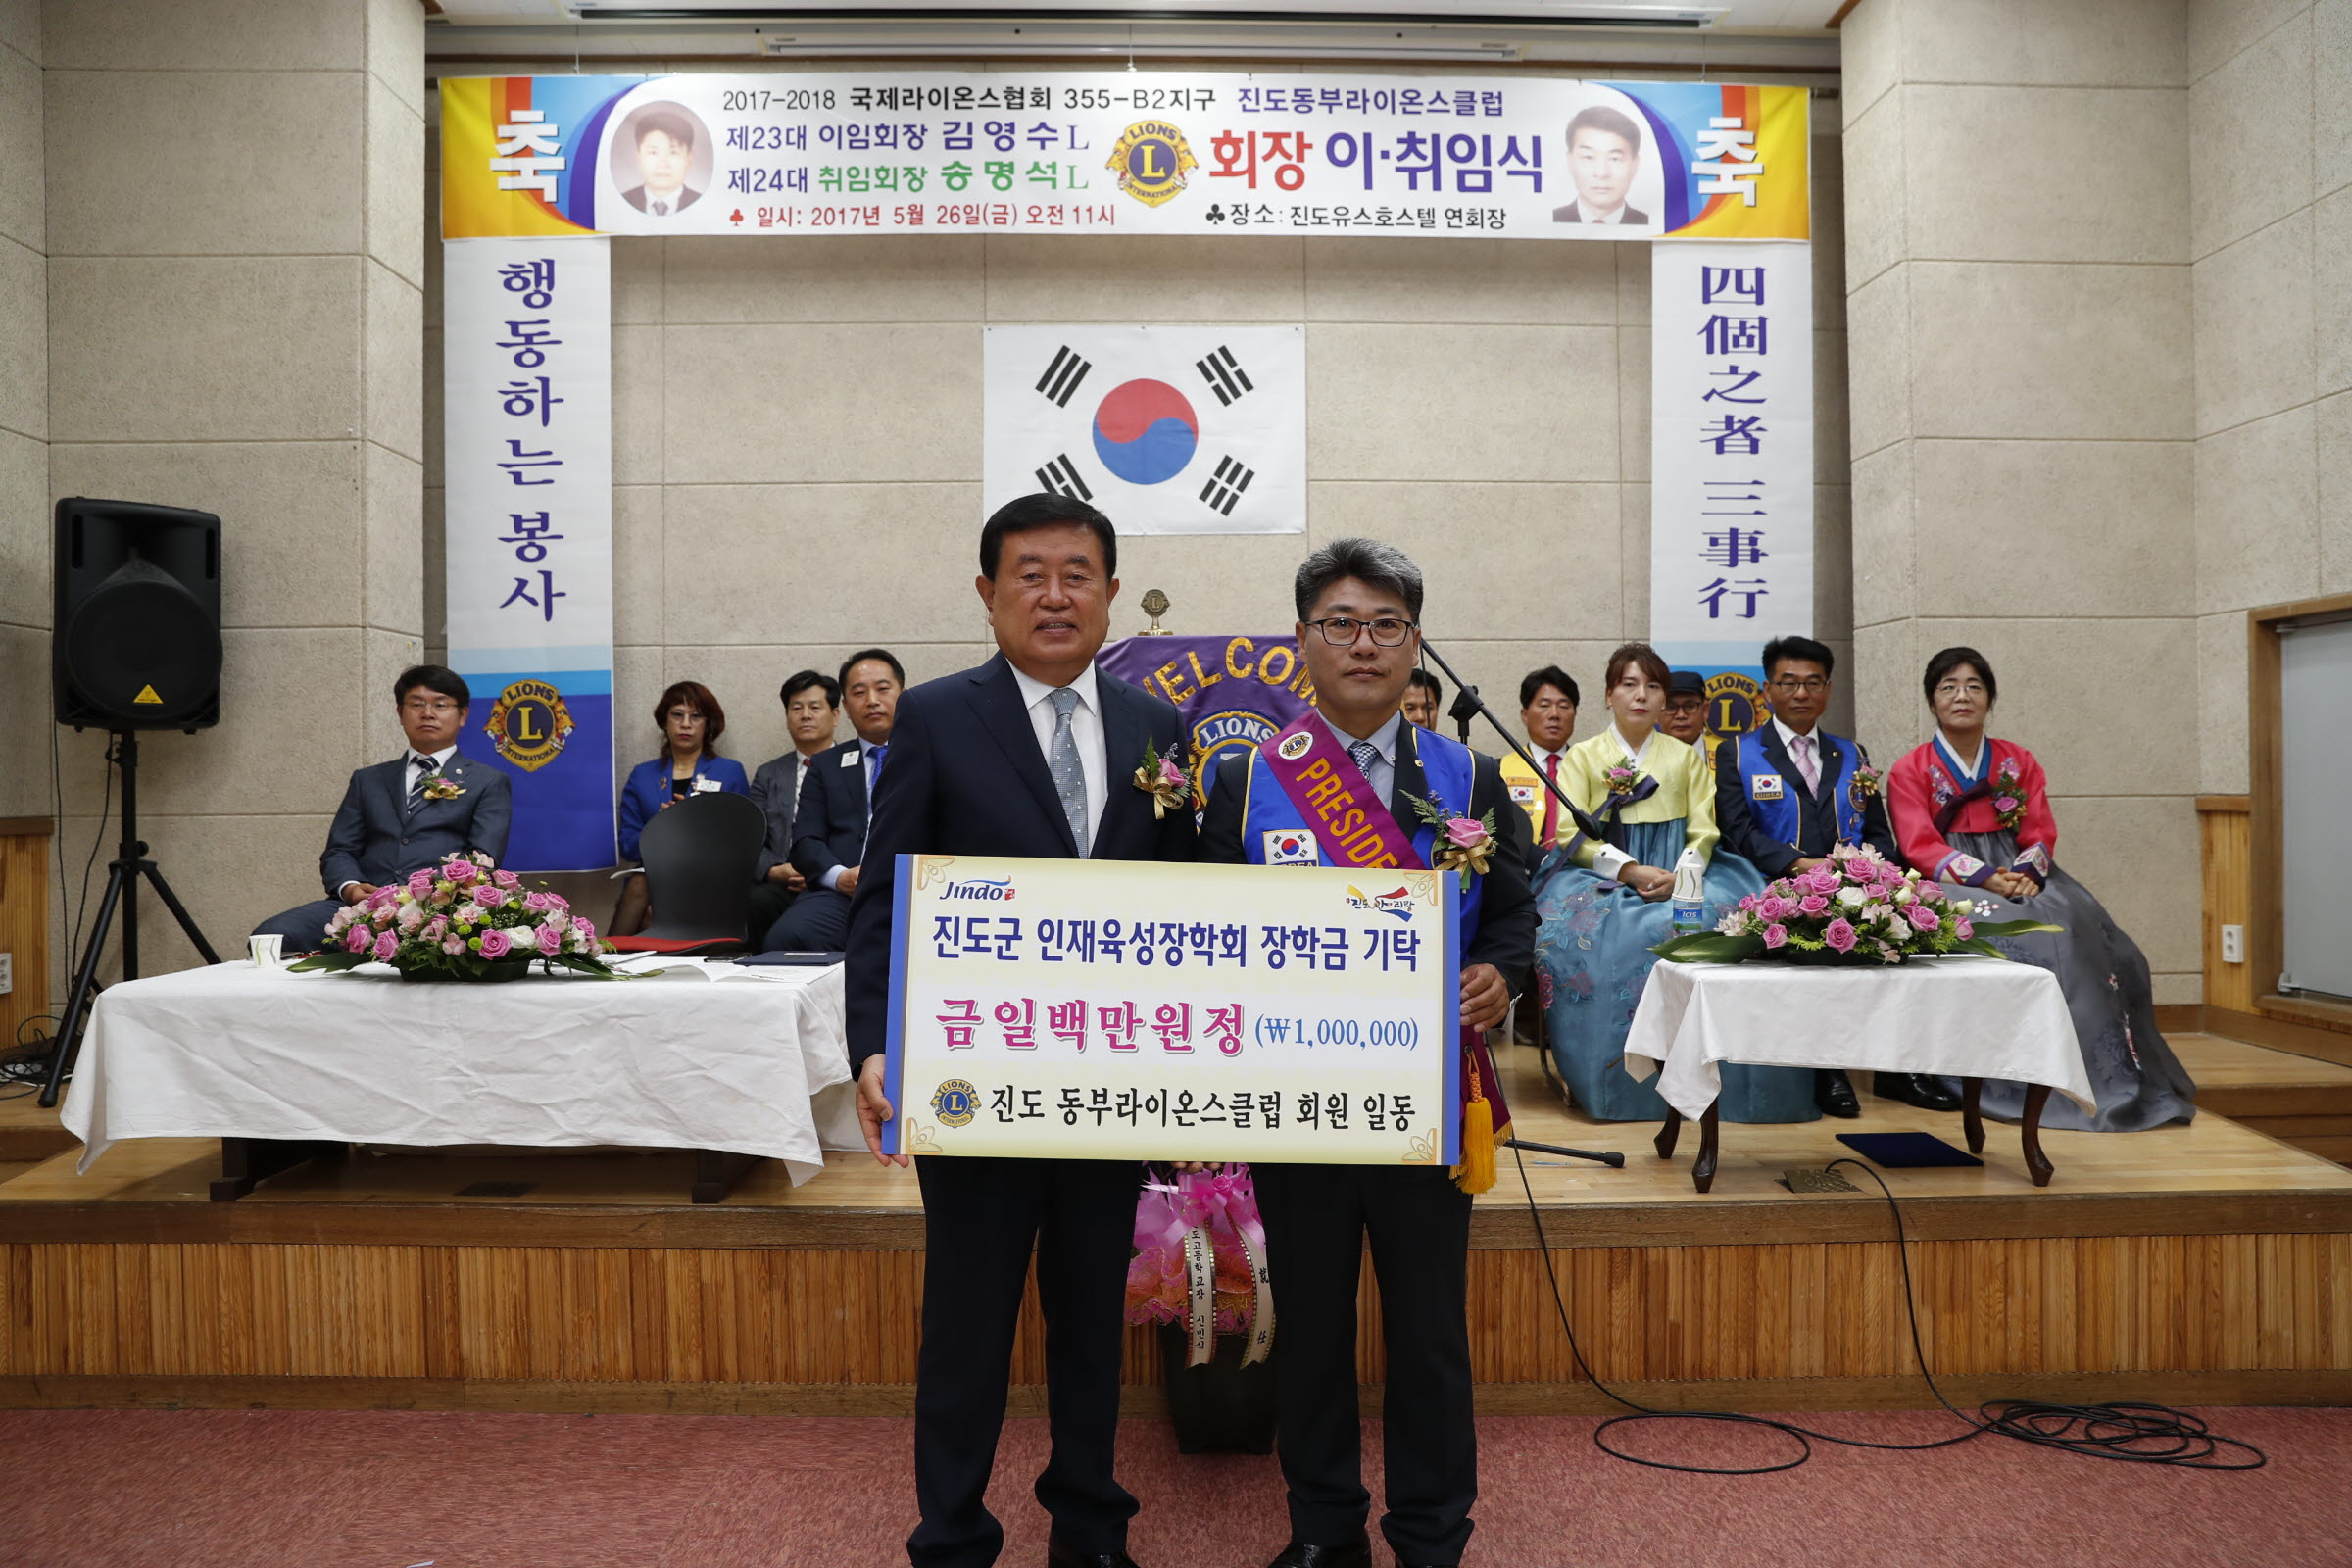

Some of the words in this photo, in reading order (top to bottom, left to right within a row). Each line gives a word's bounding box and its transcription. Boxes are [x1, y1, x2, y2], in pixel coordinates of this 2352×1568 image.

[725, 87, 836, 110] 2017-2018
[850, 86, 1050, 111] 국제라이온스협회
[1064, 88, 1216, 111] 355-B2지구
[1239, 88, 1502, 117] 진도동부라이온스클럽
[726, 124, 807, 151] 제23대
[819, 123, 928, 151] 이임회장
[1129, 123, 1177, 140] LIONS
[490, 110, 565, 202] 축
[1141, 145, 1166, 177] L
[1209, 129, 1313, 191] 회장
[1691, 117, 1764, 206] 축
[728, 167, 808, 194] 제24대
[818, 165, 928, 193] 취임회장
[758, 206, 801, 227] 일시:
[811, 205, 880, 226] 2017년
[894, 204, 923, 225] 5월
[937, 203, 1017, 226] 26일(금)
[1026, 204, 1063, 225] 오전
[1073, 205, 1114, 225] 11시
[1291, 206, 1436, 228] 진도유스호스텔
[1445, 208, 1506, 230] 연회장
[495, 259, 564, 486] 행동하는
[1697, 266, 1768, 455] 四個之者
[1698, 480, 1769, 619] 三事行
[498, 512, 566, 622] 봉사
[1143, 637, 1317, 707] ELCOM
[1708, 676, 1755, 694] LIONS
[507, 683, 555, 701] LIONS
[518, 707, 543, 740] L
[1718, 699, 1742, 731] L
[939, 881, 1003, 901] Jindo
[933, 916, 1023, 960] 진도군
[1038, 919, 1246, 967] 인재육성장학회
[1261, 925, 1349, 970] 장학금
[1363, 929, 1421, 972] 기탁
[1255, 1014, 1418, 1051] (₩1,000,000)
[942, 1081, 971, 1092] LIONS
[950, 1095, 963, 1110] L
[991, 1085, 1045, 1122] 진도
[1057, 1088, 1281, 1129] 동부라이온스클럽
[1296, 1092, 1348, 1131] 회원
[1363, 1093, 1416, 1132] 일동
[1192, 1225, 1204, 1300] 도고등학교장
